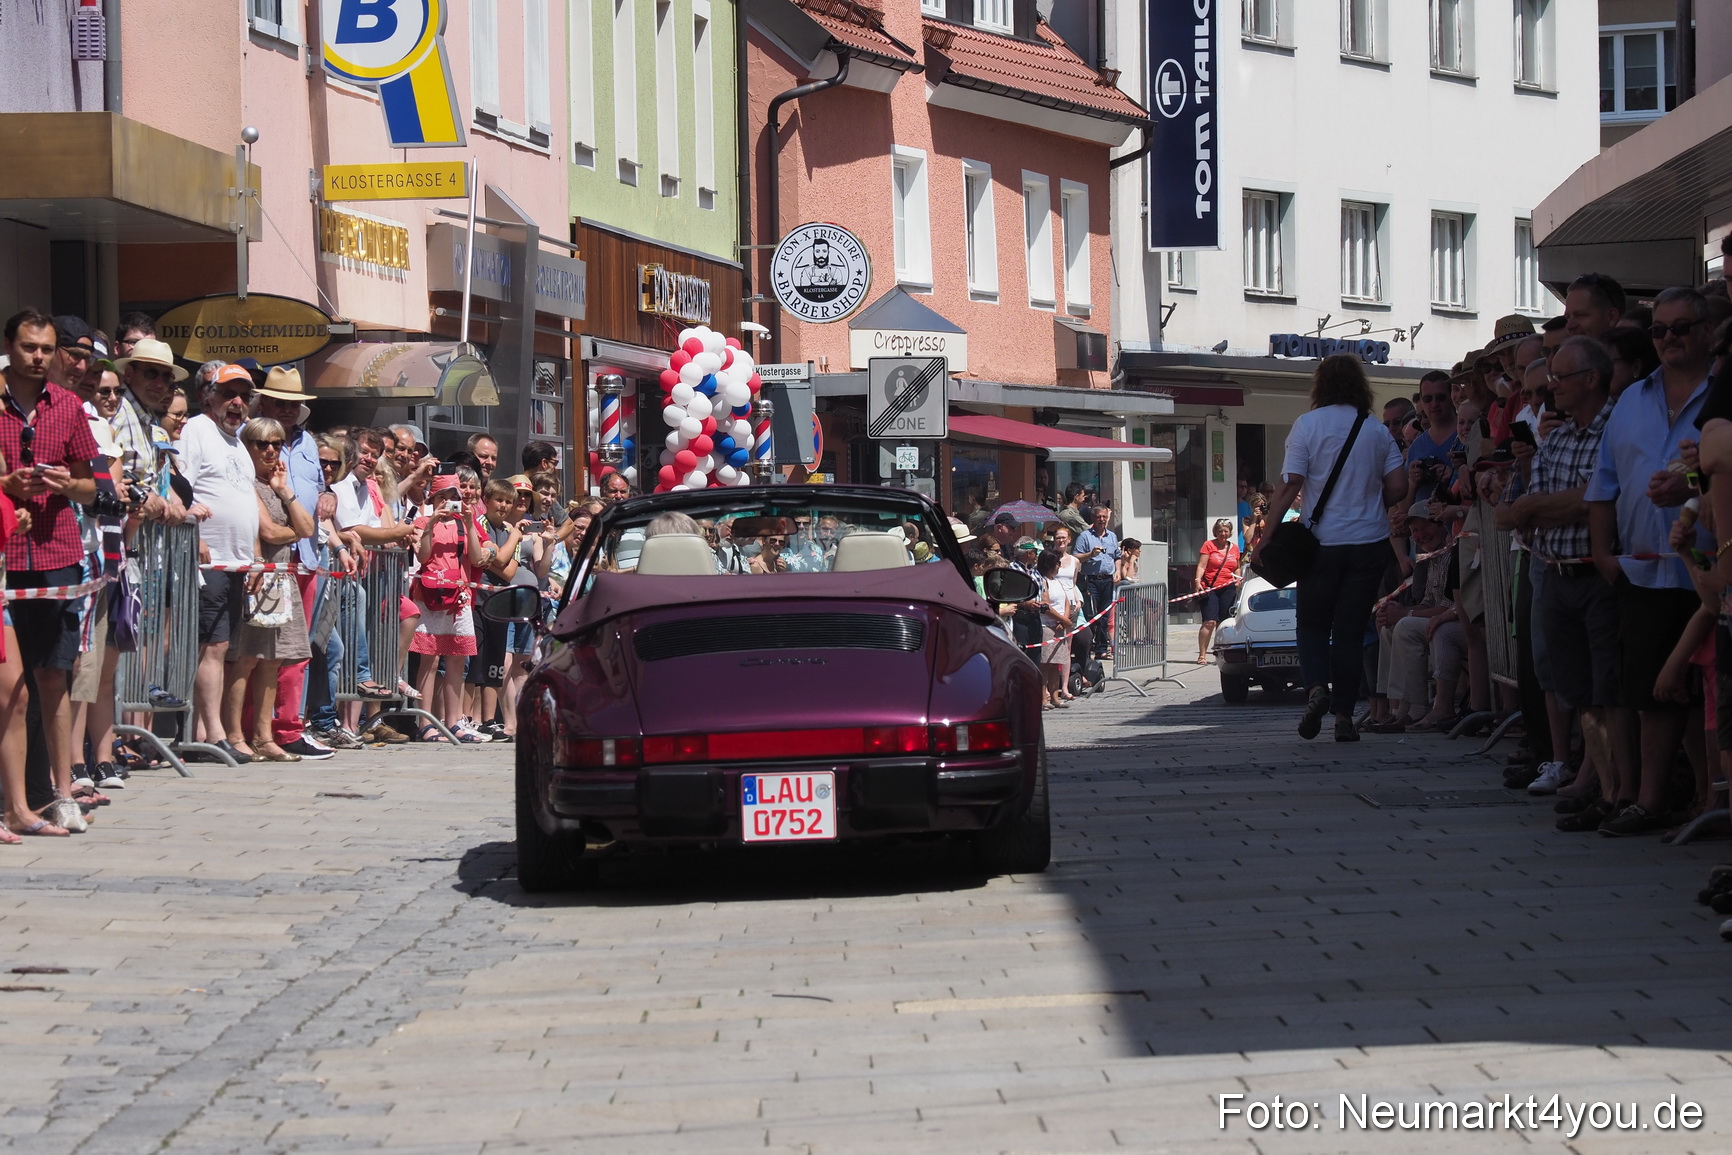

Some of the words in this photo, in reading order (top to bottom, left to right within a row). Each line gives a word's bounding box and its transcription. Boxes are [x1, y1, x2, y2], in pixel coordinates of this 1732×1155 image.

[335, 0, 397, 44] B
[1194, 112, 1211, 219] TOM
[331, 174, 442, 189] KLOSTERGASSE
[449, 172, 457, 186] 4
[813, 229, 861, 262] FRISEURE
[162, 325, 191, 338] DIE
[194, 324, 327, 339] GOLDSCHMIEDE
[874, 331, 946, 356] Creppresso
[206, 346, 237, 354] JUTTA
[240, 345, 279, 354] ROTHER
[1271, 334, 1322, 357] TOM
[755, 367, 802, 377] Klostergasse
[888, 417, 926, 430] ZONE
[758, 777, 813, 804] LAU
[754, 808, 823, 836] 0752
